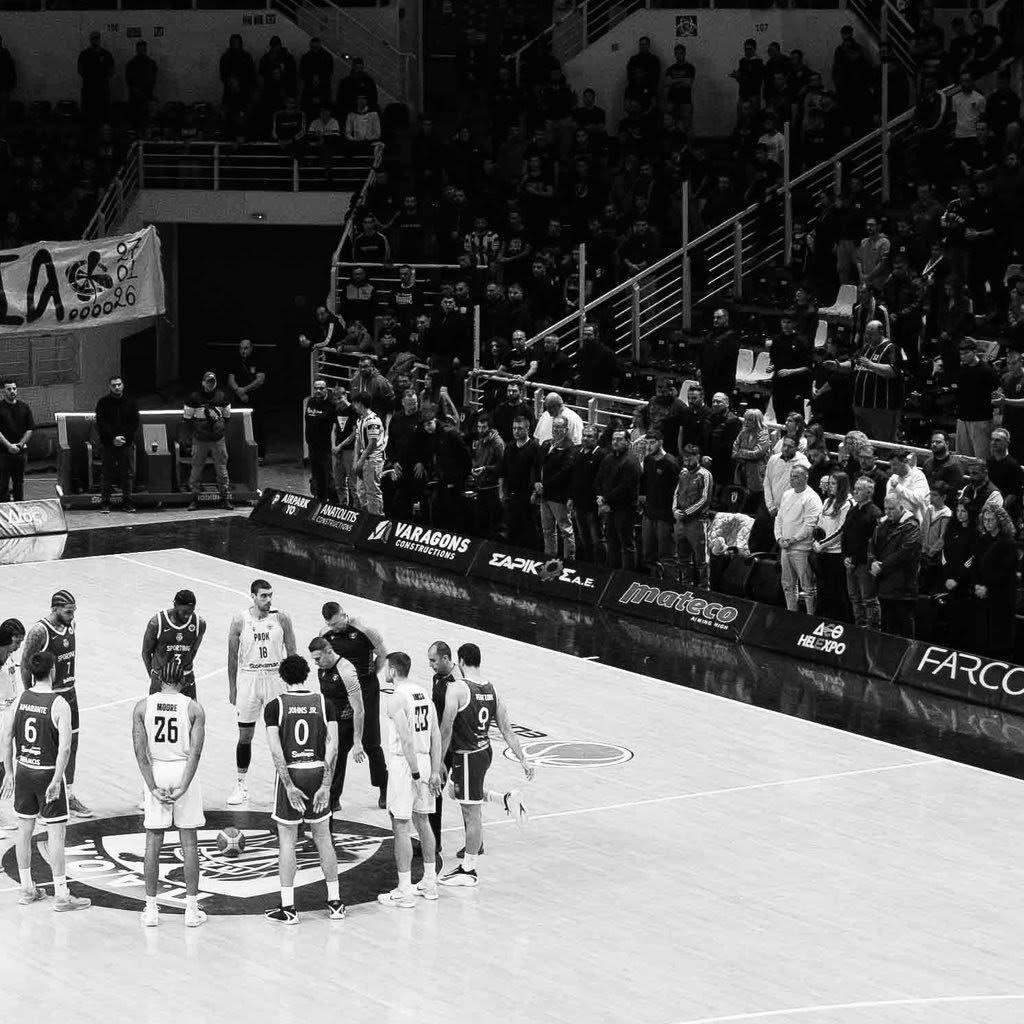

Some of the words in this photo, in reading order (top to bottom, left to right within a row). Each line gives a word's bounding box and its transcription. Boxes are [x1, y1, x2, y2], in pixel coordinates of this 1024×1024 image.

[280, 493, 312, 509] AIRPARK
[395, 522, 471, 553] VARAGONS
[395, 539, 456, 560] CONSTRUCTIONS
[619, 581, 738, 623] mateco
[253, 632, 270, 642] PAOK
[796, 635, 846, 655] HELEXPO
[19, 702, 48, 715] AMARANTE
[156, 703, 178, 712] MOORE
[287, 706, 307, 715] JOHNS
[477, 706, 490, 731] 9
[24, 717, 37, 743] 6
[154, 716, 179, 744] 26
[294, 718, 310, 746] 0
